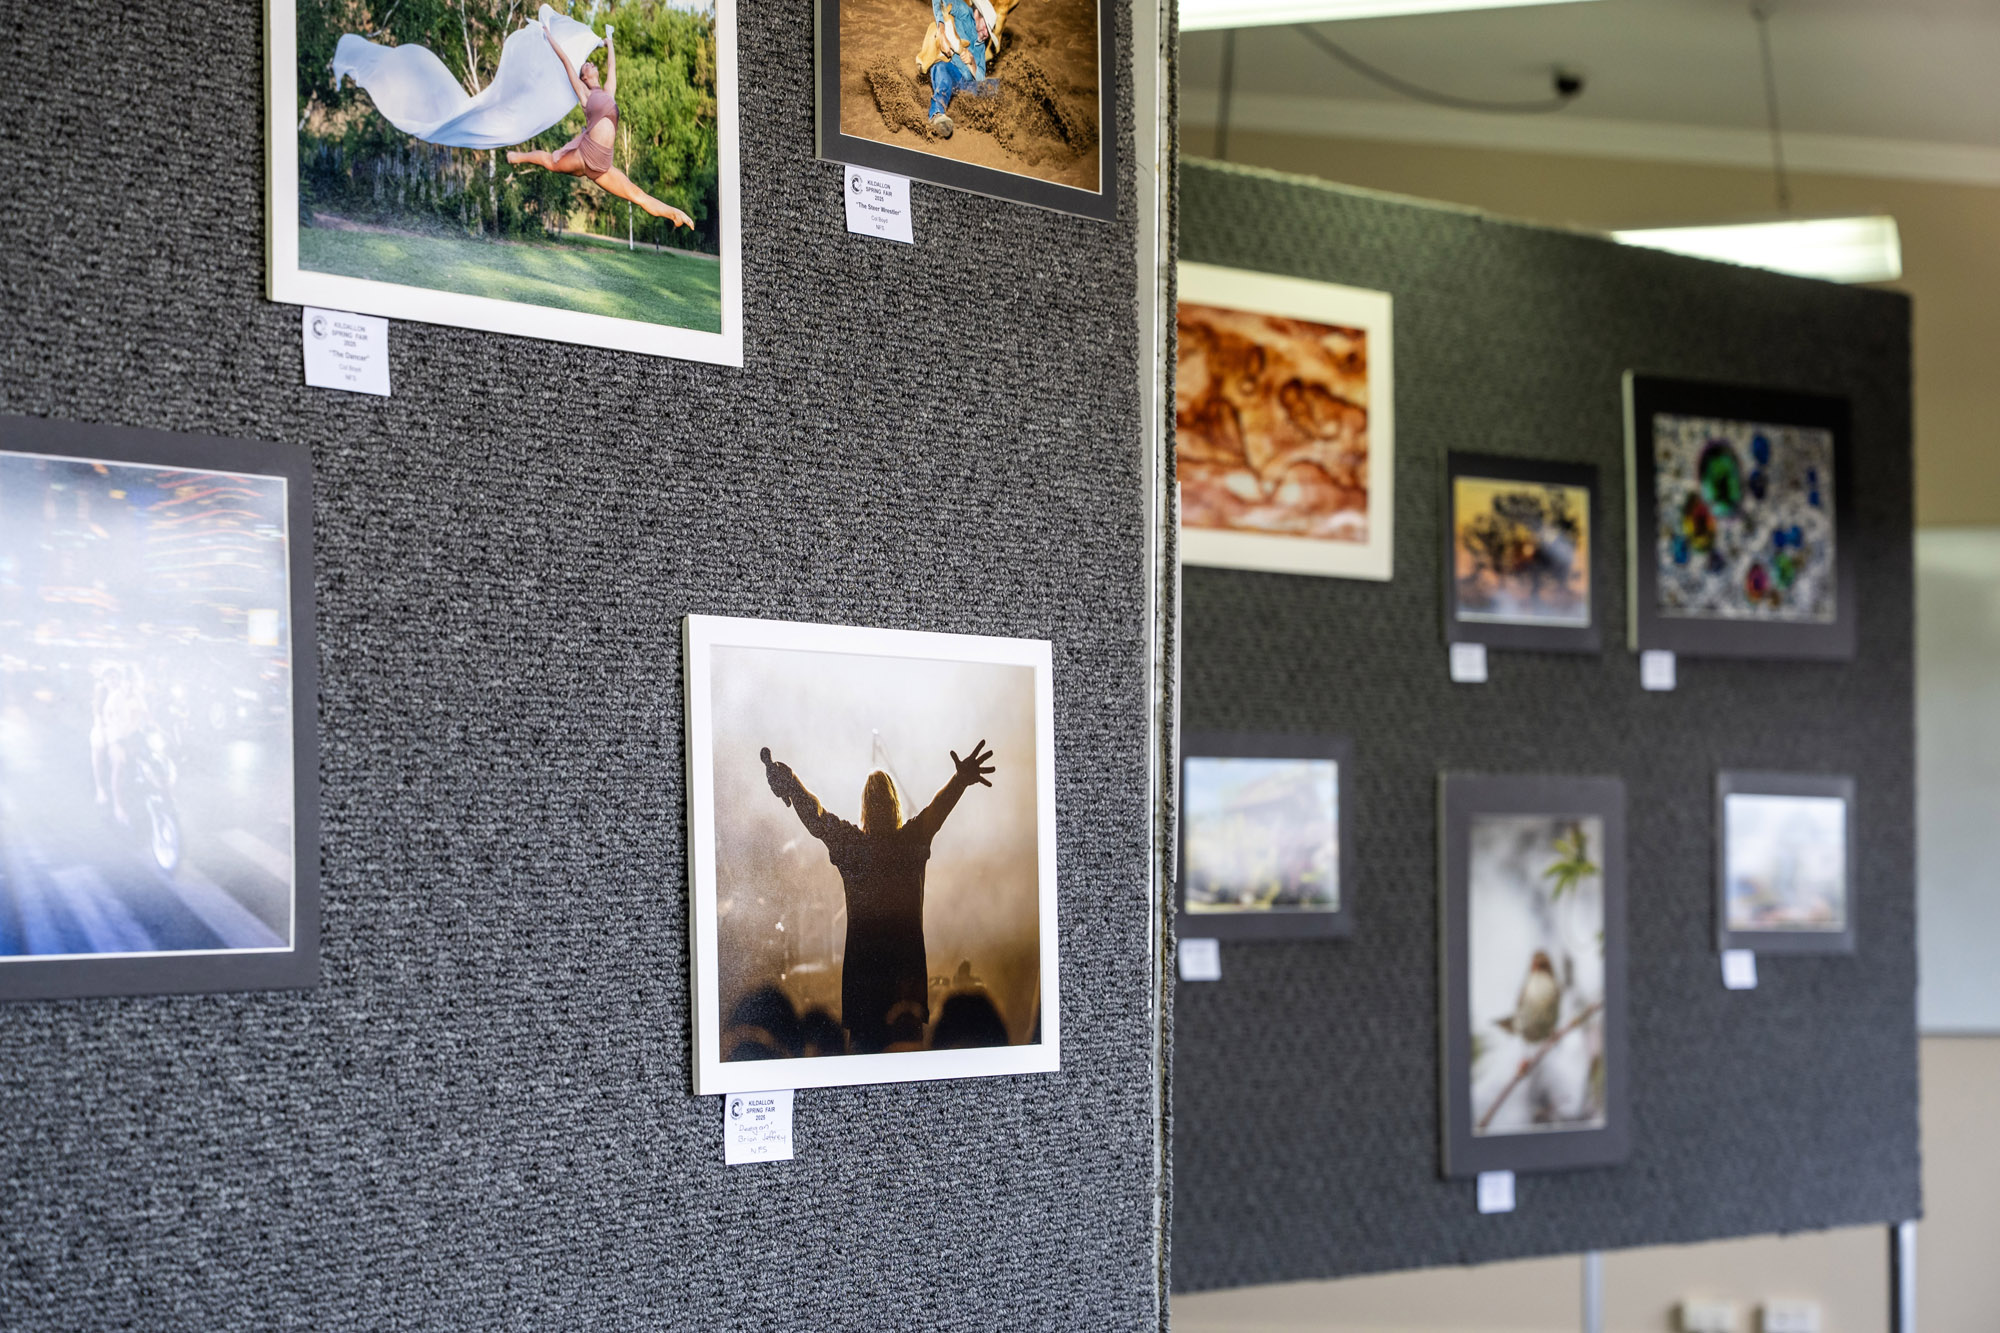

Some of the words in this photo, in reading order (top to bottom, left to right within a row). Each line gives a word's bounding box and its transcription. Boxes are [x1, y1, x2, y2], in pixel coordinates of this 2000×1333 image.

[867, 180, 891, 189] KILDALLON
[334, 322, 366, 332] KILDALLON
[332, 330, 353, 339] SPRING
